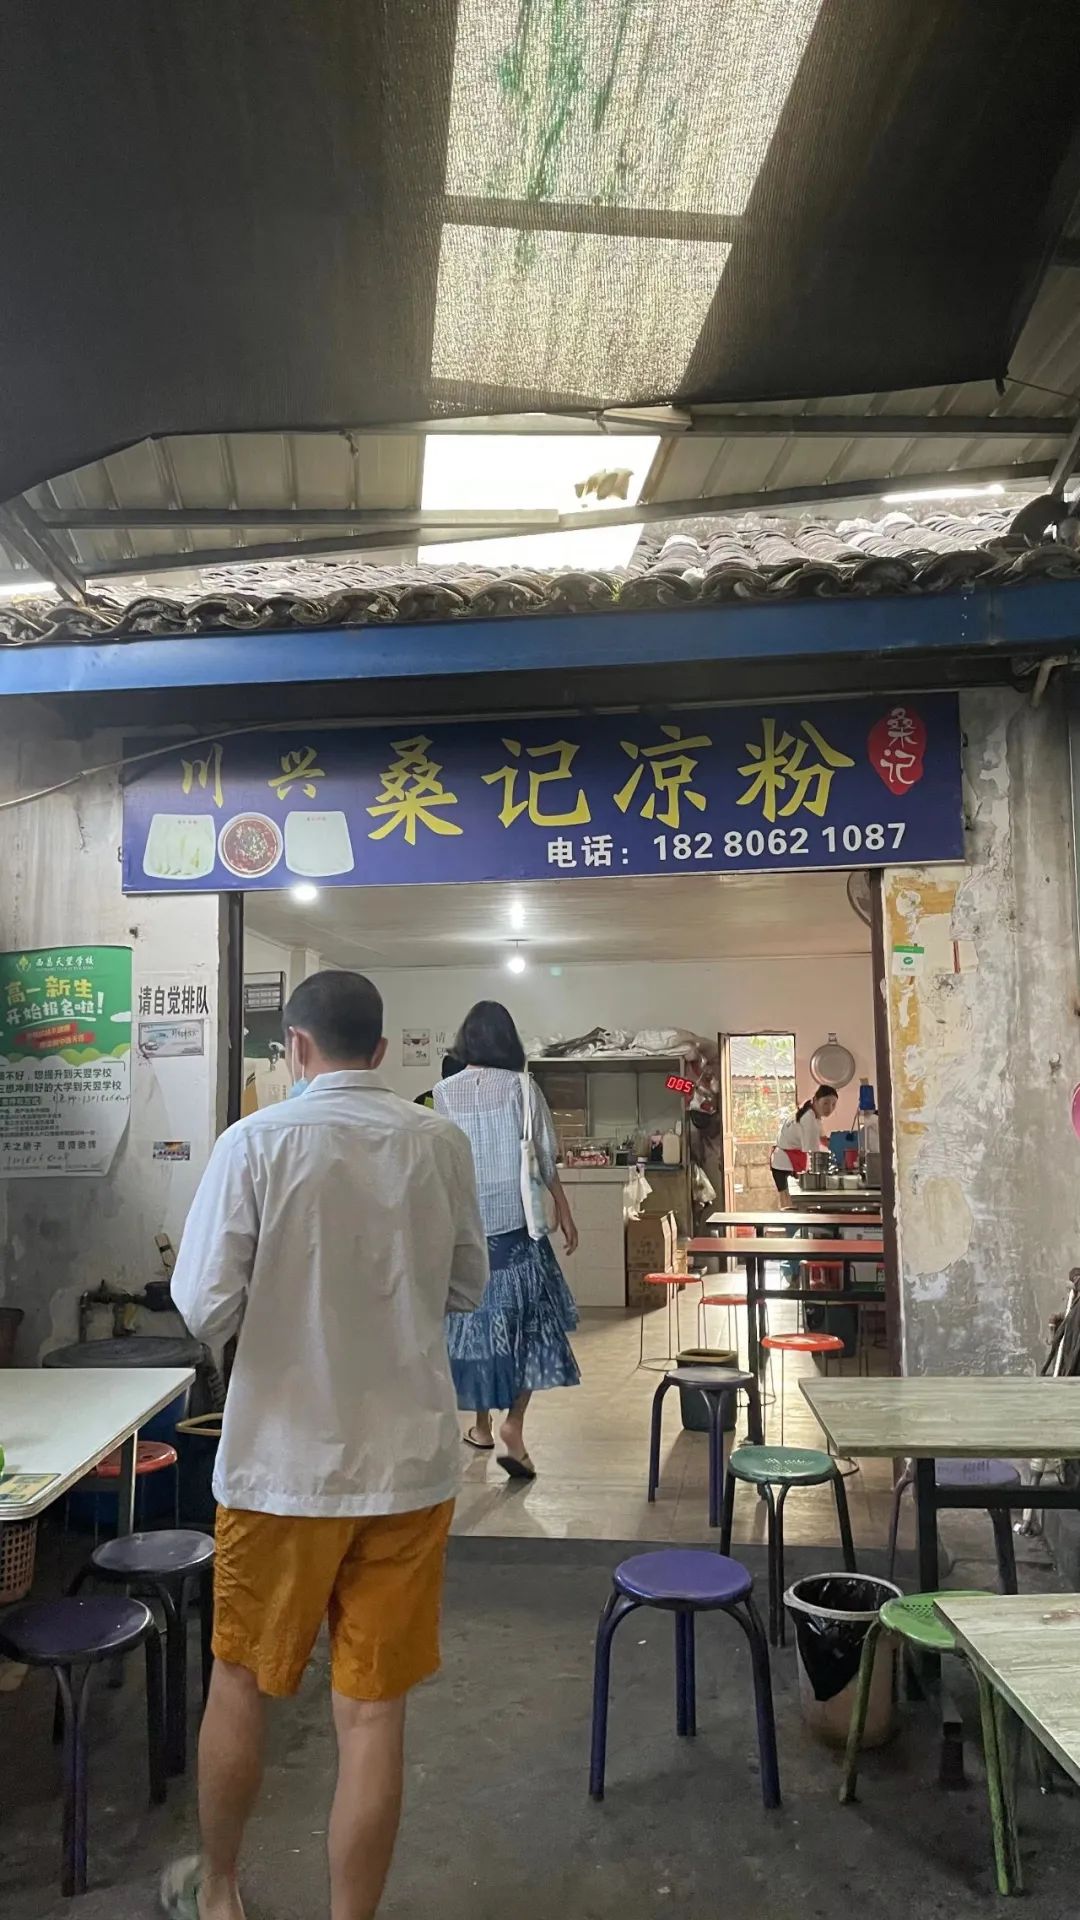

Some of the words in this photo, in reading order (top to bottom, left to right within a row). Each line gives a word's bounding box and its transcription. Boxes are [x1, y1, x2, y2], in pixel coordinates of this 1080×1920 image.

[879, 705, 918, 787] 桑记
[365, 718, 856, 846] 桑记凉粉
[652, 831, 713, 862] 182
[723, 827, 809, 857] 8062
[822, 822, 906, 853] 1087
[5, 975, 93, 1005] 高一新生
[138, 985, 209, 1016] 请自觉排队
